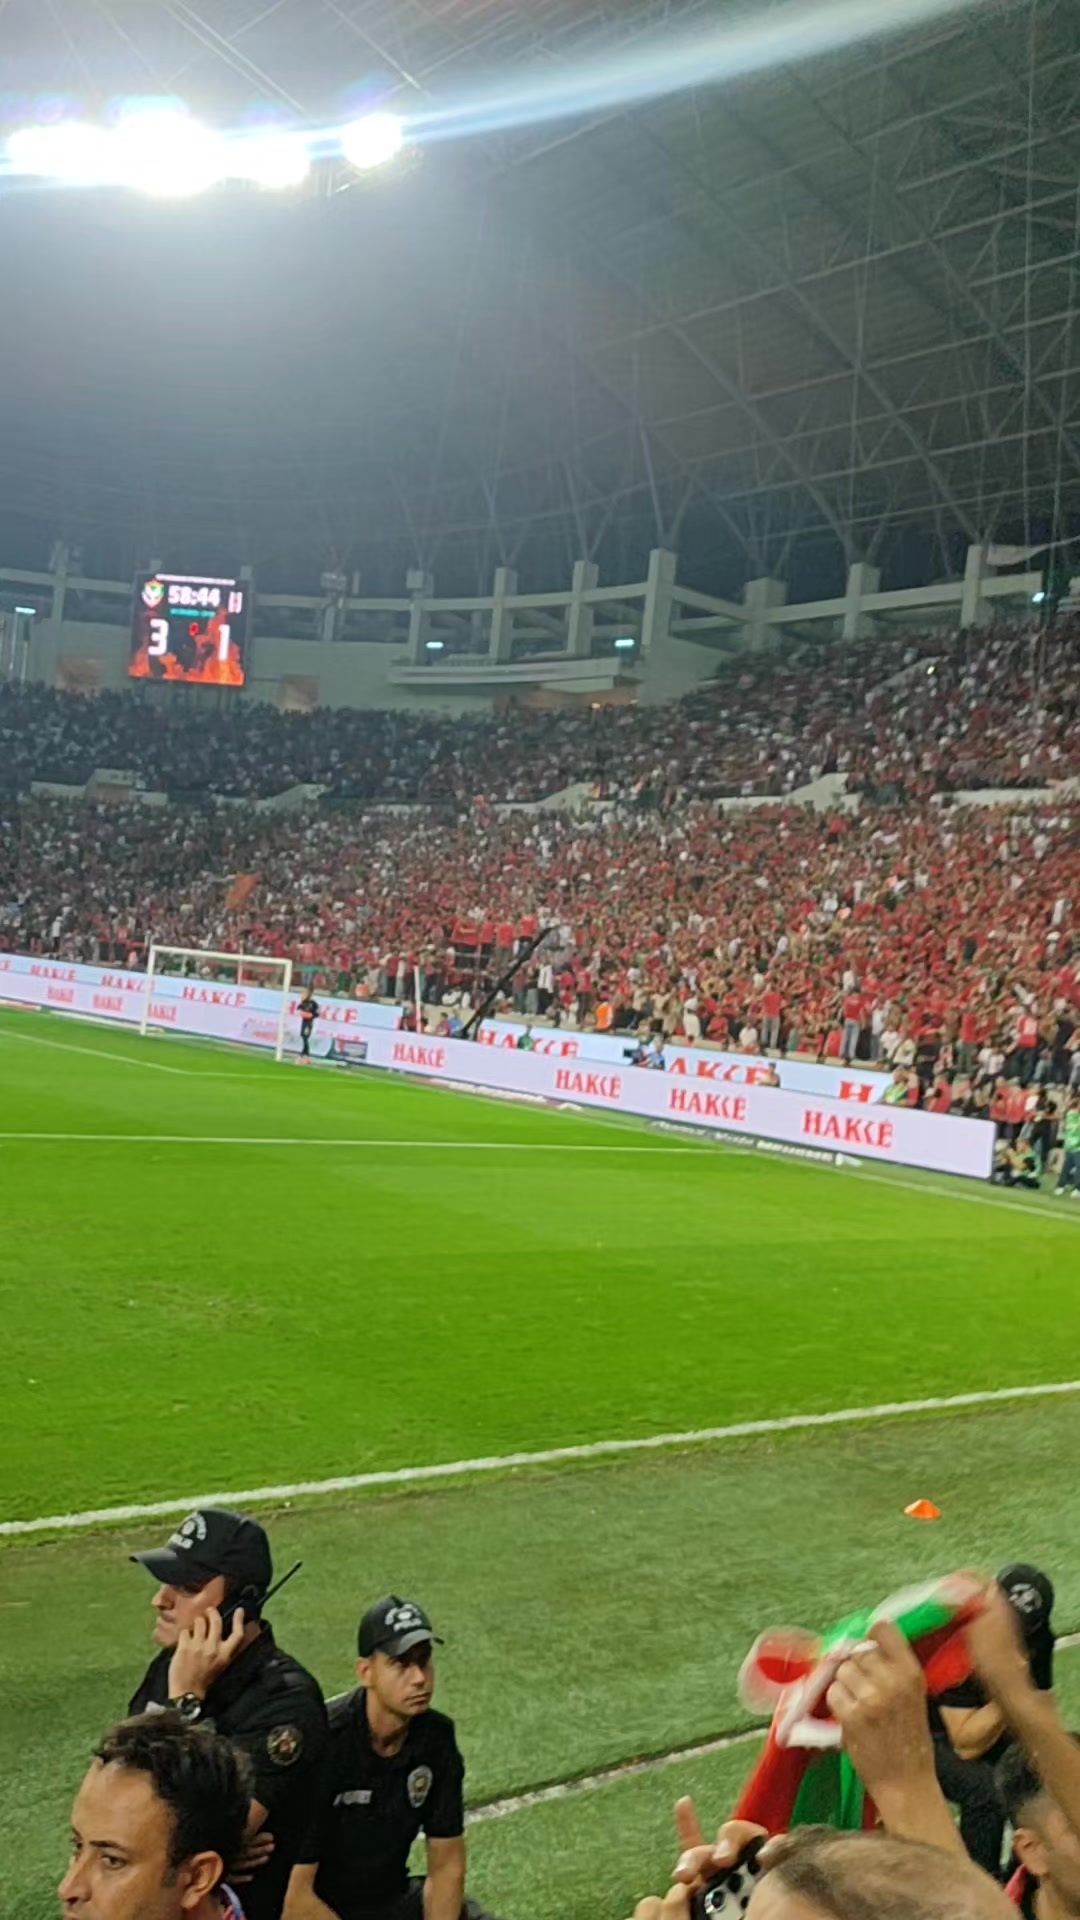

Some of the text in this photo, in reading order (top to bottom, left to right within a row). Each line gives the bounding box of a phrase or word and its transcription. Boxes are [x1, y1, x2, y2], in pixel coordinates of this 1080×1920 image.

[168, 585, 221, 607] 58:44
[148, 618, 169, 655] 3
[218, 624, 230, 662] 1
